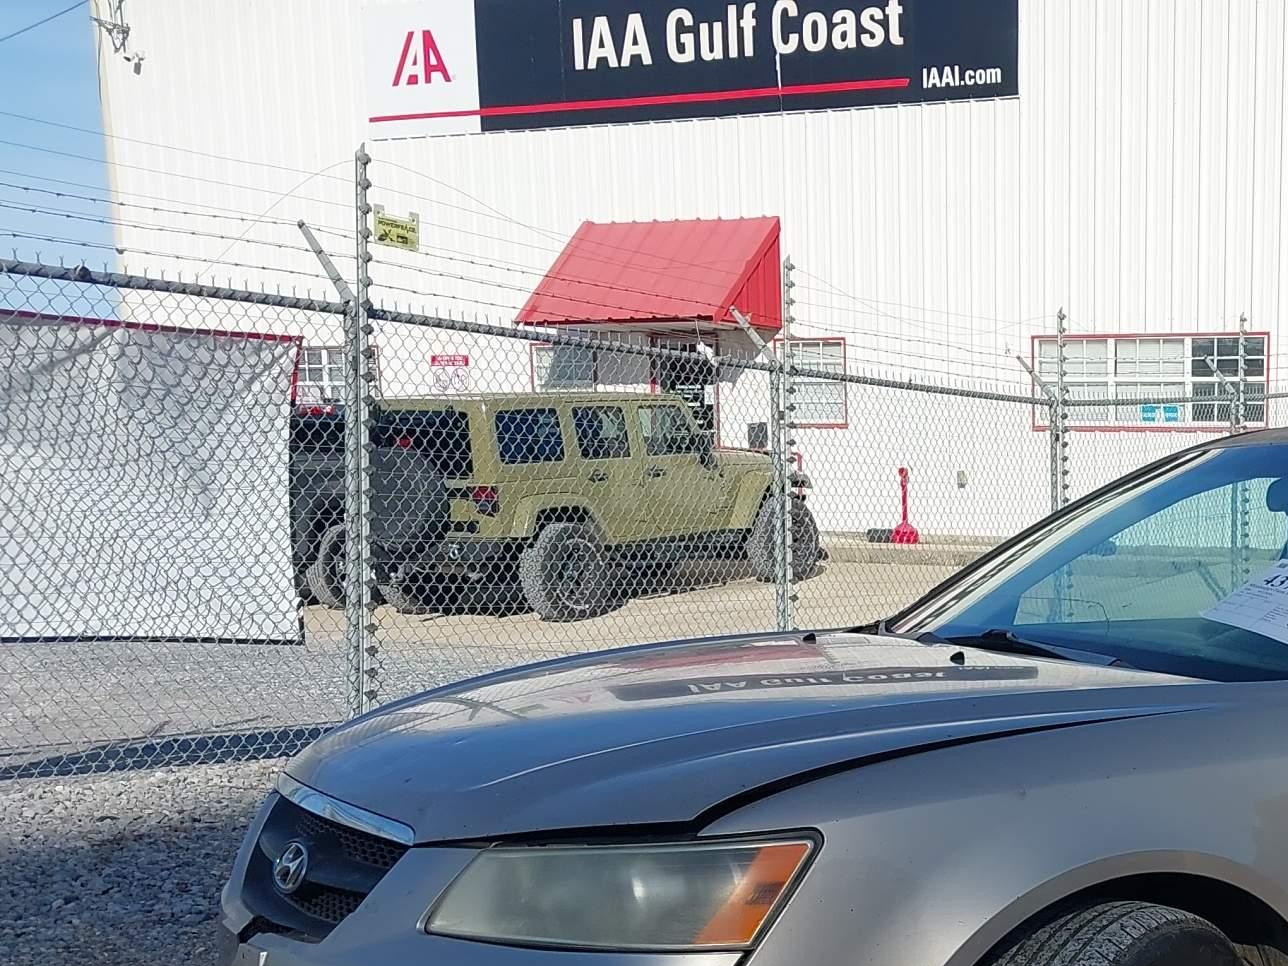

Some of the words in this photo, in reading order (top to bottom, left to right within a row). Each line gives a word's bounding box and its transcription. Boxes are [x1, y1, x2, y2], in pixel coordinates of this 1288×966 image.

[571, 10, 653, 71] IAA
[666, 2, 756, 64] Gulf
[772, 0, 904, 54] Coast
[922, 65, 1002, 89] IAAI.com
